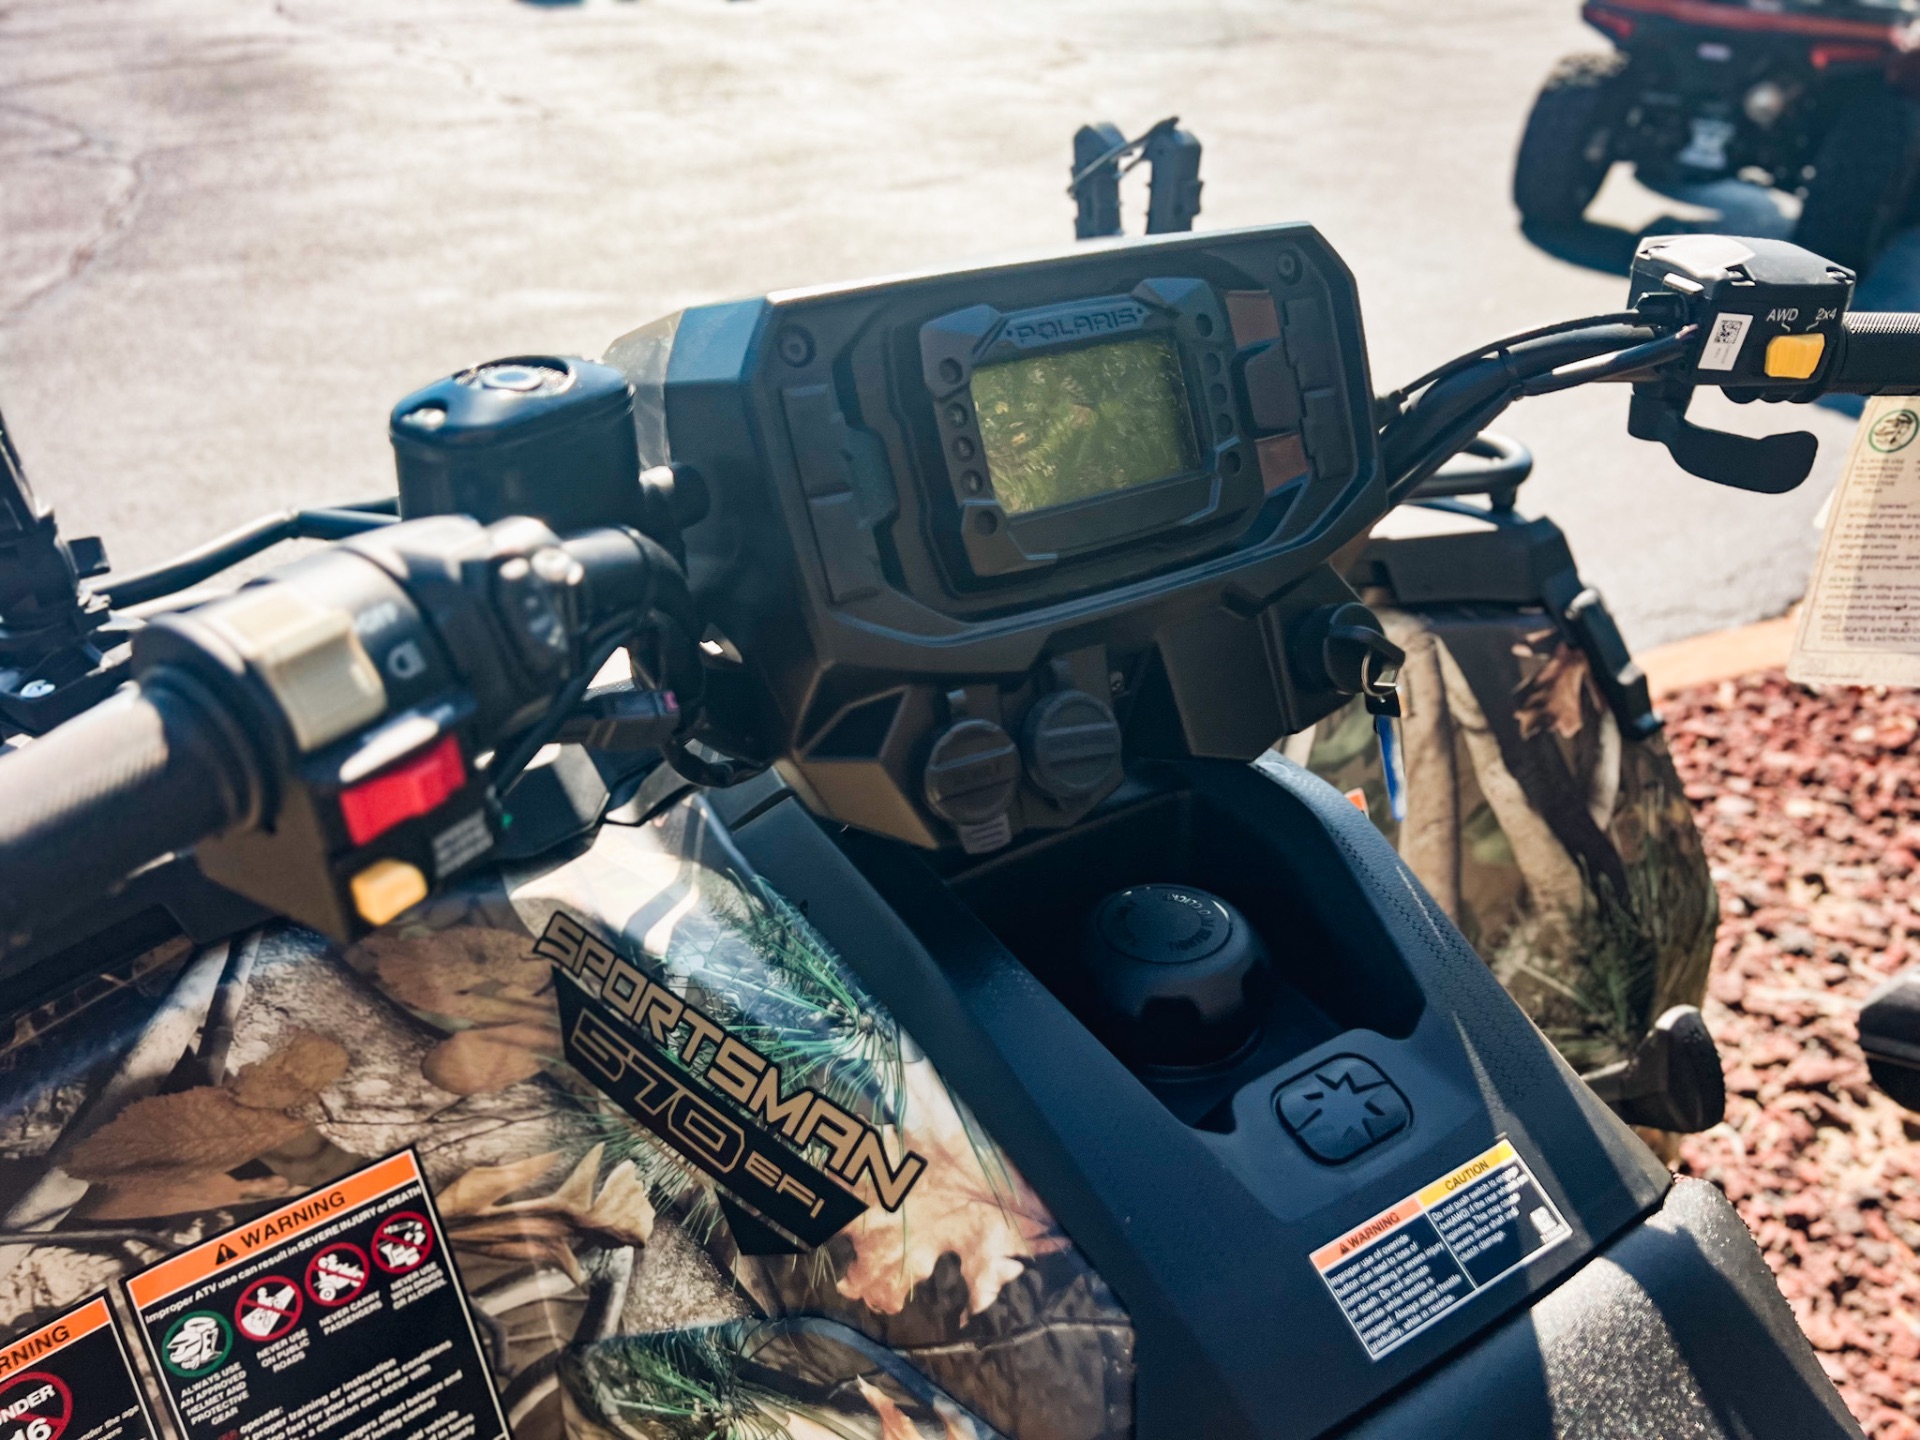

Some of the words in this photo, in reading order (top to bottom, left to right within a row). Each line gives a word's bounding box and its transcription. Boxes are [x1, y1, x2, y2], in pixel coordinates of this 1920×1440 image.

[1016, 307, 1138, 344] POLARIS
[1766, 308, 1799, 321] AWD
[1815, 307, 1838, 320] 2x4
[534, 911, 927, 1211] SPORTSMAN
[744, 1150, 826, 1219] EFI
[1444, 1160, 1489, 1191] CAUTION
[239, 1191, 345, 1248] WARNING
[1347, 1212, 1400, 1248] WARNING
[1430, 1211, 1444, 1223] Do
[1441, 1203, 1455, 1216] not
[144, 1295, 193, 1324] Improper
[195, 1282, 216, 1300] ATV
[217, 1275, 237, 1289] use
[237, 1265, 258, 1279] can
[257, 1249, 288, 1270] result
[287, 1245, 299, 1256] in
[297, 1224, 340, 1250] SEVERE
[339, 1206, 376, 1231] INJURY
[386, 1185, 422, 1208] DEATH
[1358, 1270, 1373, 1283] can
[1386, 1256, 1397, 1266] to
[1360, 1255, 1374, 1267] use
[1373, 1248, 1383, 1260] of
[390, 1271, 419, 1290] NEVER
[419, 1261, 437, 1275] USE
[390, 1284, 413, 1300] WITH
[412, 1269, 443, 1289] DRUGS
[392, 1297, 407, 1309] OR
[407, 1277, 446, 1303] ALCOHOL
[1378, 1288, 1393, 1300] Do
[1390, 1279, 1404, 1293] not
[319, 1306, 349, 1327] NEVER
[349, 1290, 379, 1311] CARRY
[323, 1300, 382, 1335] PASSENGERS
[0, 1326, 71, 1370] RNING
[256, 1338, 288, 1359] NEVER
[288, 1328, 308, 1343] USE
[260, 1355, 276, 1367] ON
[276, 1337, 309, 1360] PUBLIC
[272, 1350, 305, 1372] ROADS
[180, 1396, 194, 1409] AN
[195, 1370, 246, 1401] APPROVED
[181, 1372, 221, 1398] ALWAYS
[220, 1361, 241, 1377] USE
[285, 1418, 307, 1436] fast
[306, 1410, 322, 1424] for
[323, 1397, 345, 1417] your
[346, 1384, 372, 1403] skills
[371, 1377, 383, 1389] or
[383, 1368, 401, 1382] the
[401, 1340, 452, 1372] conditions
[0, 1384, 56, 1425] NDER
[186, 1391, 223, 1416] HELMET
[226, 1381, 246, 1397] AND
[190, 1390, 249, 1425] PROTECTIVE
[211, 1406, 238, 1425] GEAR
[251, 1416, 287, 1440] proper
[287, 1394, 329, 1421] training
[329, 1387, 341, 1399] or
[342, 1358, 396, 1392] instruction
[307, 1428, 315, 1437] a
[315, 1403, 360, 1432] collision
[360, 1393, 379, 1408] can
[380, 1376, 408, 1397] occur
[409, 1364, 431, 1380] with
[340, 1419, 378, 1440] engers
[378, 1402, 406, 1424] affect
[405, 1381, 443, 1408] balance
[443, 1369, 463, 1386] and
[78, 1425, 103, 1440] nder
[239, 1406, 283, 1434] operate:
[370, 1418, 403, 1440] losing
[401, 1396, 436, 1422] control
[437, 1428, 448, 1439] in
